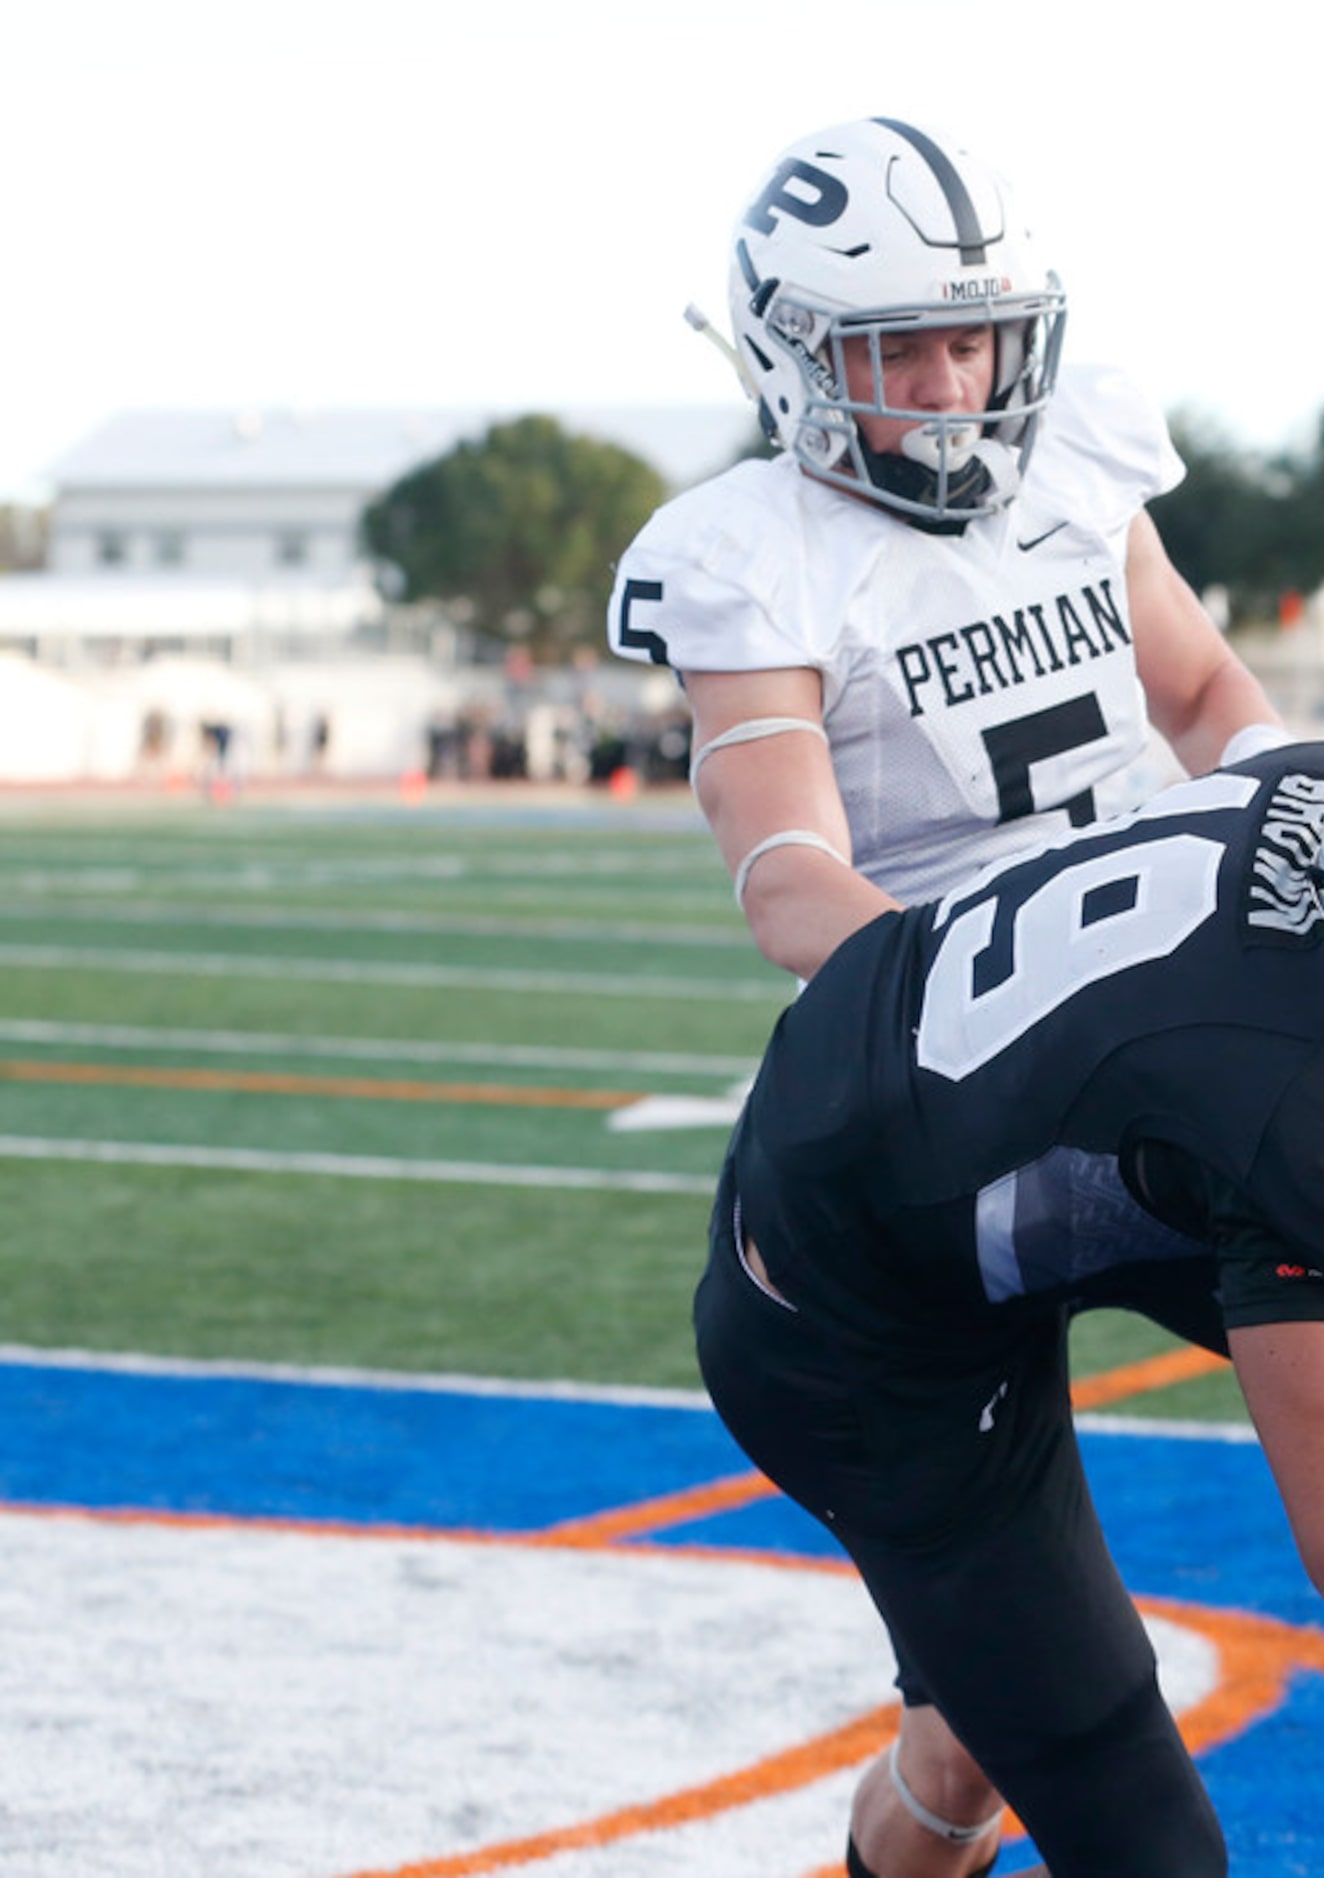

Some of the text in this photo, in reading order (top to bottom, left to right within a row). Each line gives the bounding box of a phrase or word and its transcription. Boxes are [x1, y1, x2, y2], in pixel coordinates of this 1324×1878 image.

[743, 158, 849, 237] P
[950, 278, 1000, 300] MOJO
[619, 579, 669, 665] 5
[896, 579, 1132, 717] PERMIAN
[980, 690, 1109, 829] 5
